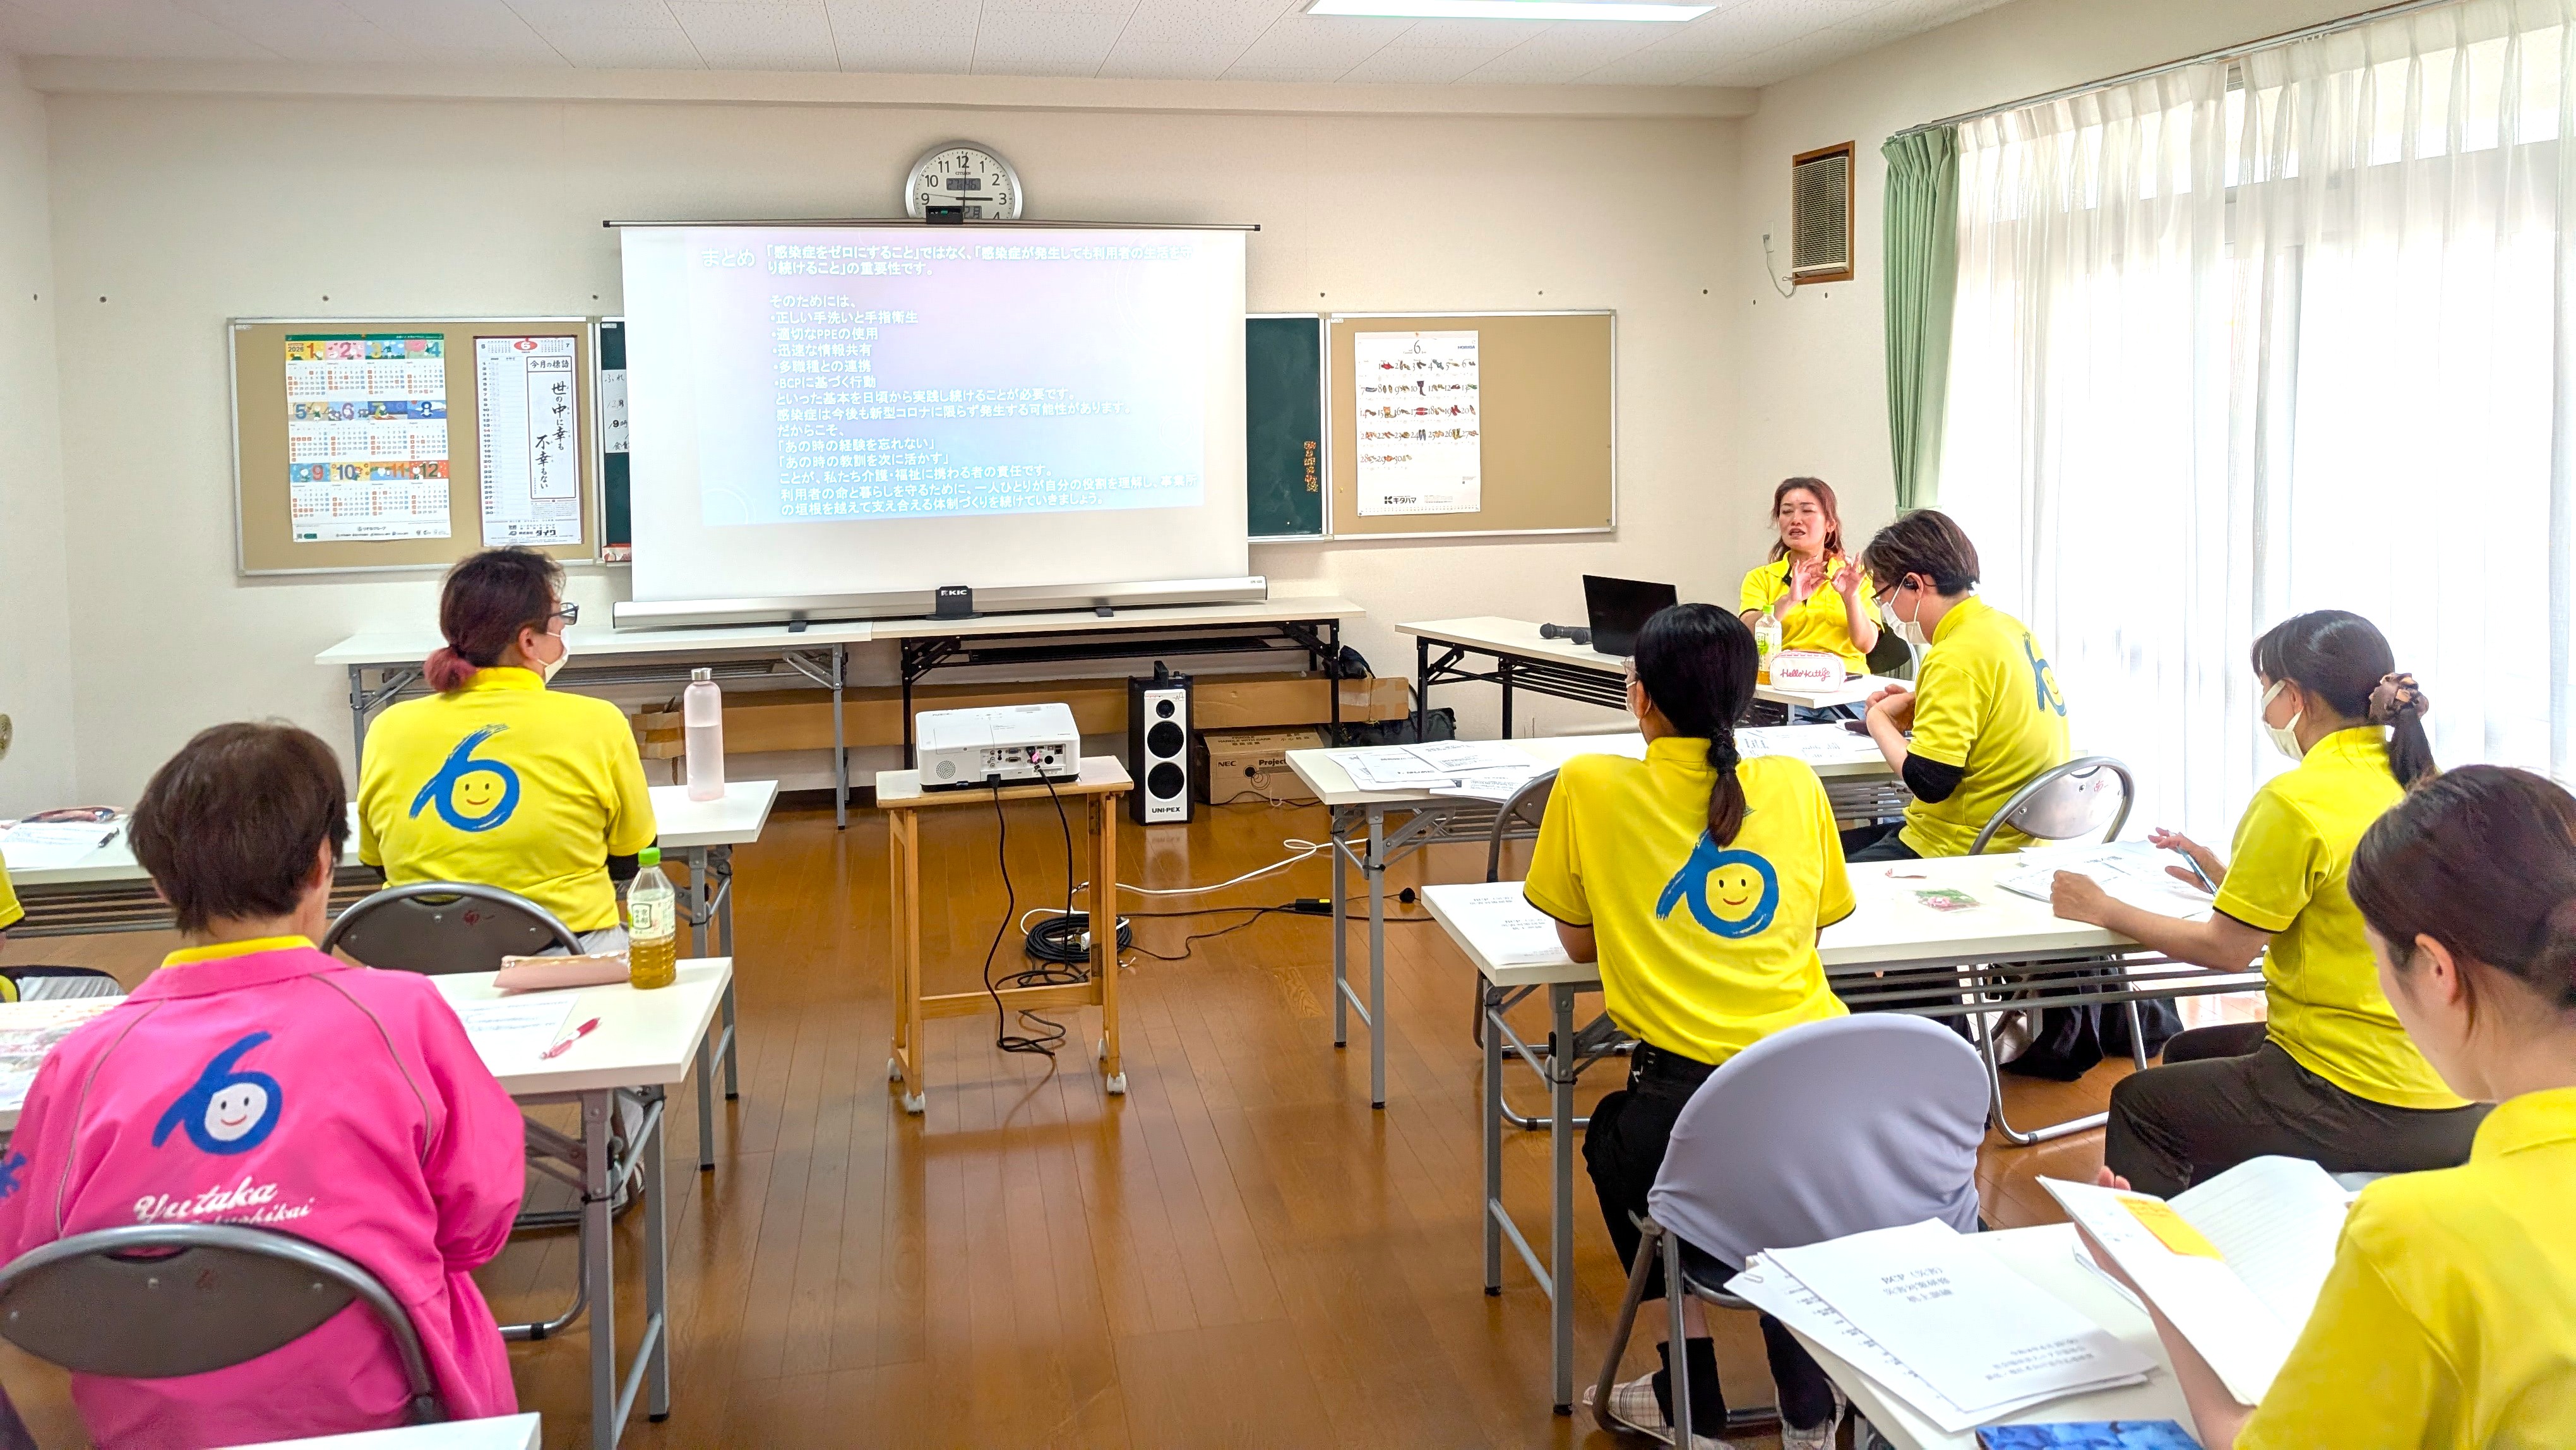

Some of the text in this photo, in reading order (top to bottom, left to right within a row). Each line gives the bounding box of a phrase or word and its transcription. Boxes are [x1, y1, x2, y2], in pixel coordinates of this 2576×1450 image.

[938, 160, 950, 173] 11
[956, 155, 970, 169] 12
[979, 160, 984, 173] 1
[924, 174, 939, 188] 10
[992, 173, 1000, 186] 2
[921, 193, 930, 205] 9
[998, 193, 1007, 205] 3
[701, 247, 756, 268] まとめ
[766, 261, 933, 276] り続けること」の重要性です。
[770, 295, 856, 308] そのためには、
[307, 343, 314, 358] 1
[340, 342, 351, 358] 2
[430, 342, 441, 357] 4
[1414, 340, 1421, 354] 6
[775, 387, 1075, 405] といった基本を日頃から実践し続けることが必要です。
[295, 404, 307, 419] 5
[342, 402, 355, 420] 6
[421, 402, 432, 417] 8
[777, 424, 844, 438] だからこそ、
[778, 437, 935, 453] 「あの時の経験を忘れない」
[778, 452, 949, 469] 「あの時の教訓を次に活かす」
[337, 464, 355, 480] 10
[391, 463, 405, 478] 11
[420, 463, 438, 478] 12
[1780, 669, 1803, 678] Hello
[133, 1176, 278, 1223] Yutaka
